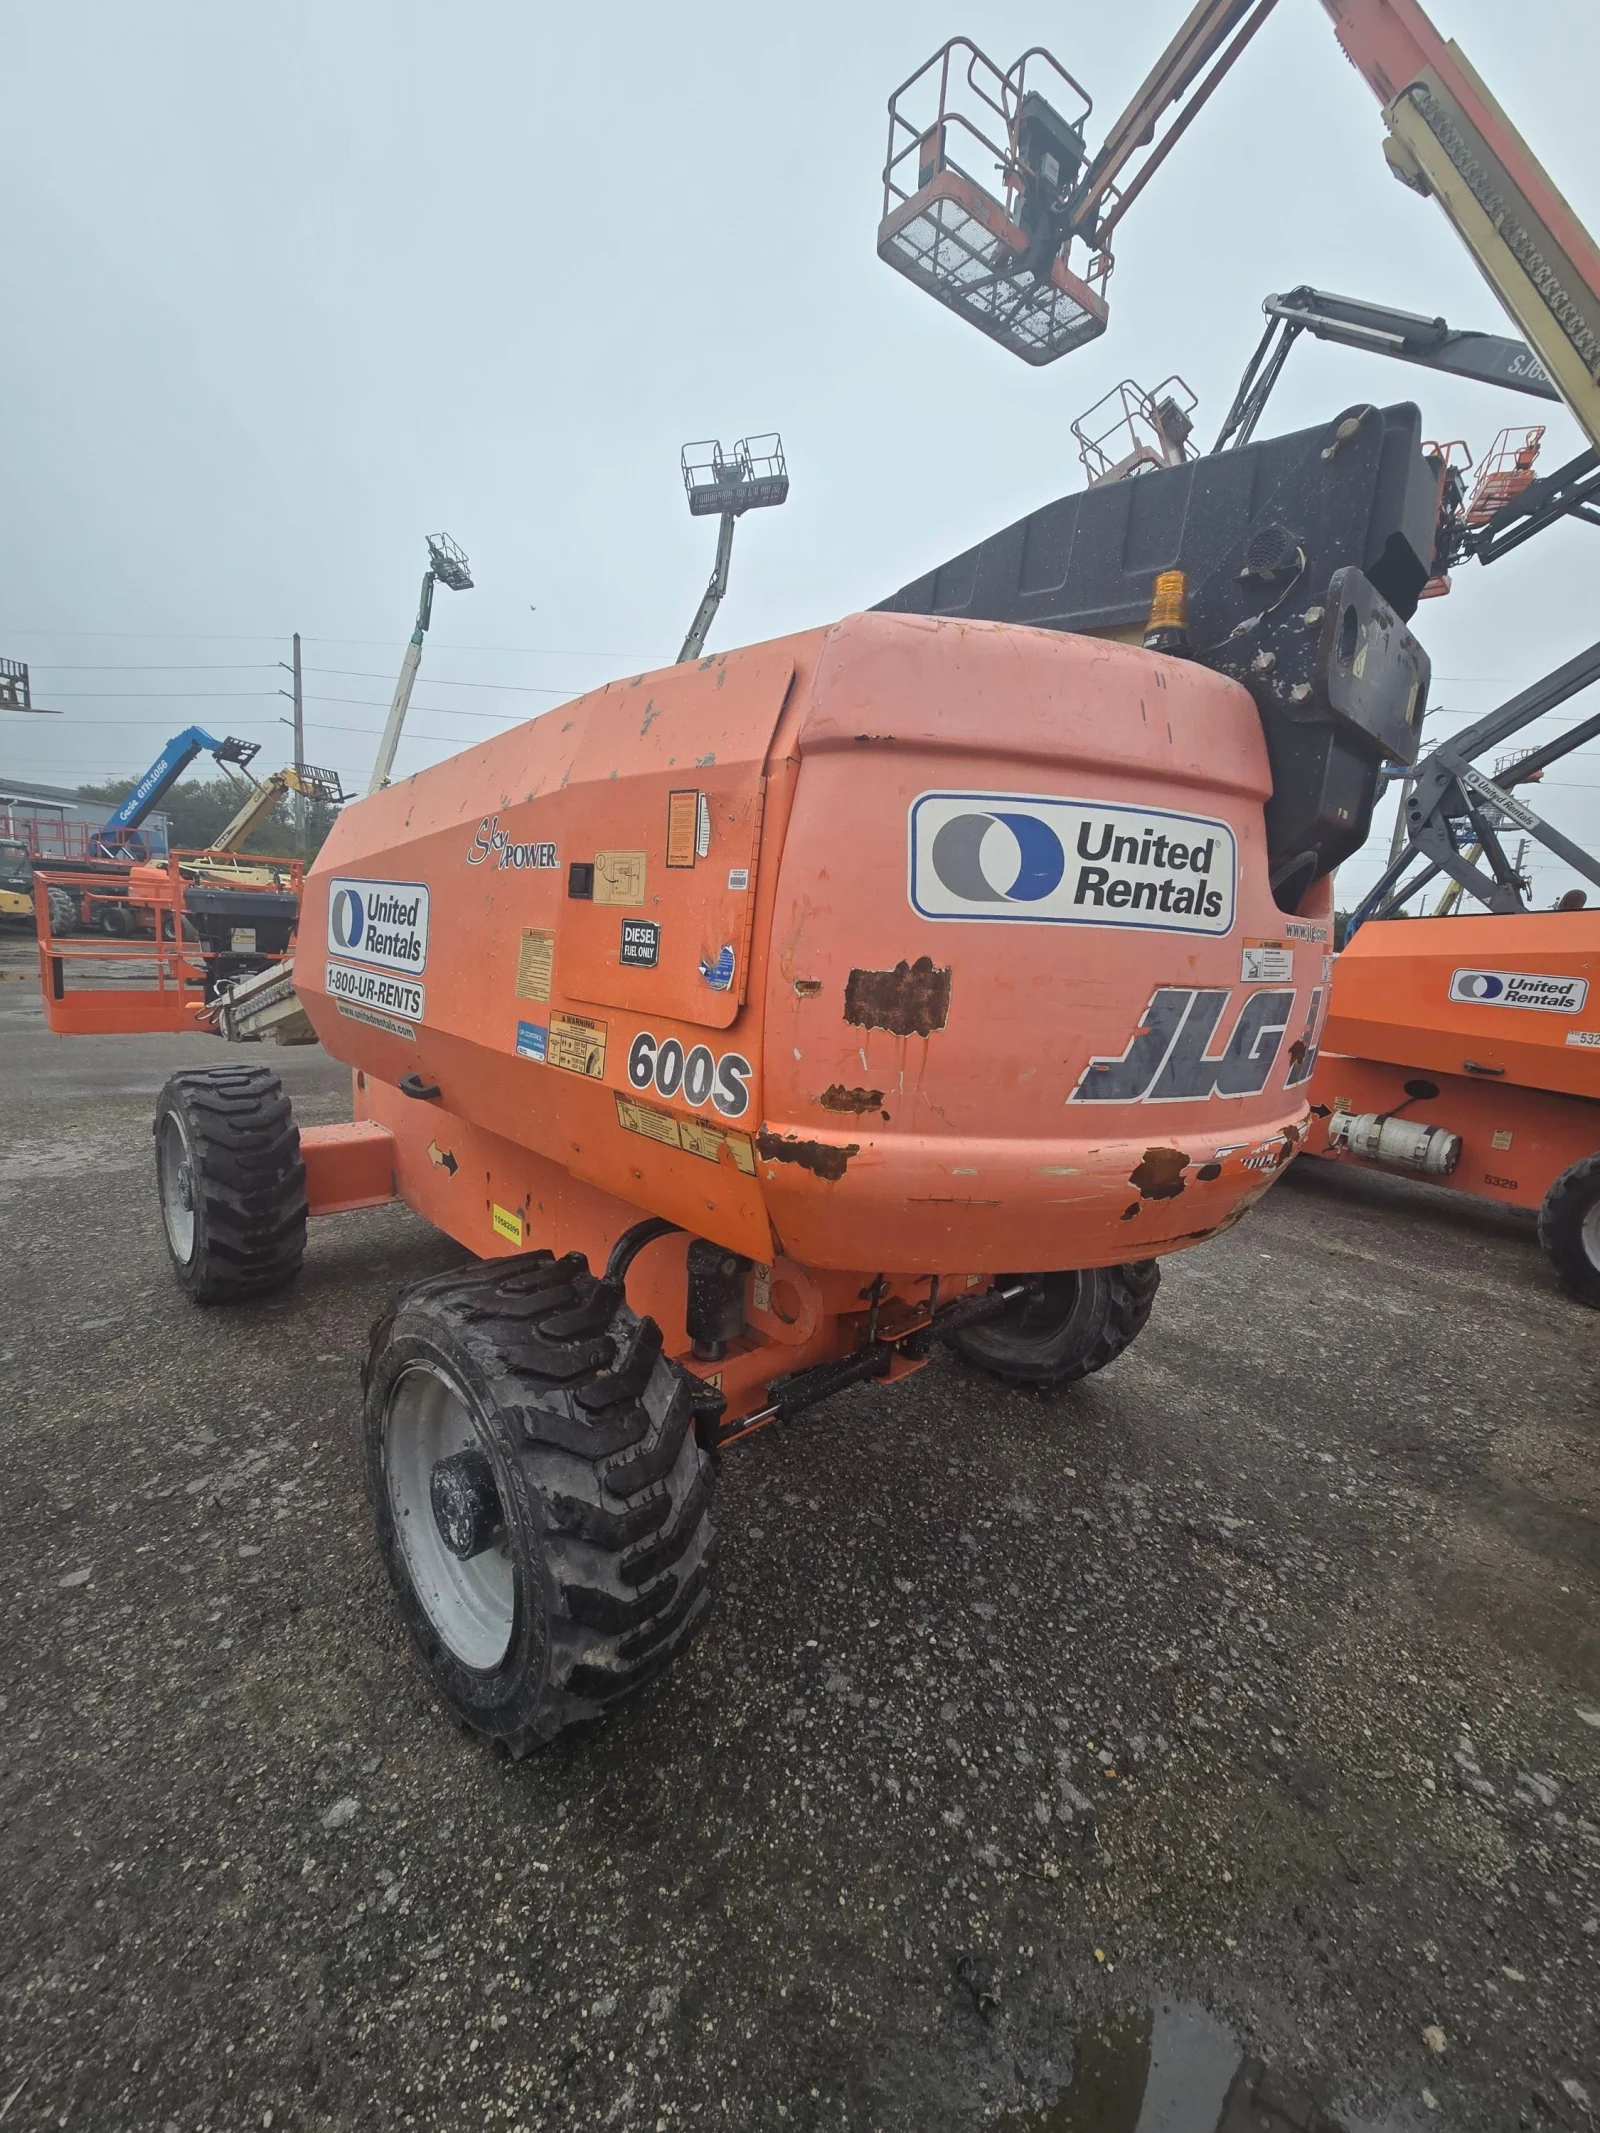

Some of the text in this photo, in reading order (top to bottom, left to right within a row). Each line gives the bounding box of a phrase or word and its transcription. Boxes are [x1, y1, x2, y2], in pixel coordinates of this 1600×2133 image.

[1507, 354, 1550, 383] SJ6
[137, 759, 168, 799] GTH-1056
[1477, 781, 1534, 826] United Rentals
[466, 815, 558, 871] Sky POWER
[1076, 821, 1214, 874] United
[1073, 866, 1223, 917] Rentals
[367, 893, 420, 927] United
[365, 925, 422, 961] Rentals
[624, 927, 656, 945] DIESEL
[624, 944, 655, 959] FUEL ONLY
[328, 968, 421, 1014] 1-800-UR-RENTS
[1503, 990, 1576, 1008] Rentals
[1508, 978, 1575, 995] United
[566, 1014, 596, 1030] WARNING
[1065, 988, 1297, 1104] JLG
[627, 1031, 753, 1118] 600S
[1483, 1173, 1518, 1191] 5329
